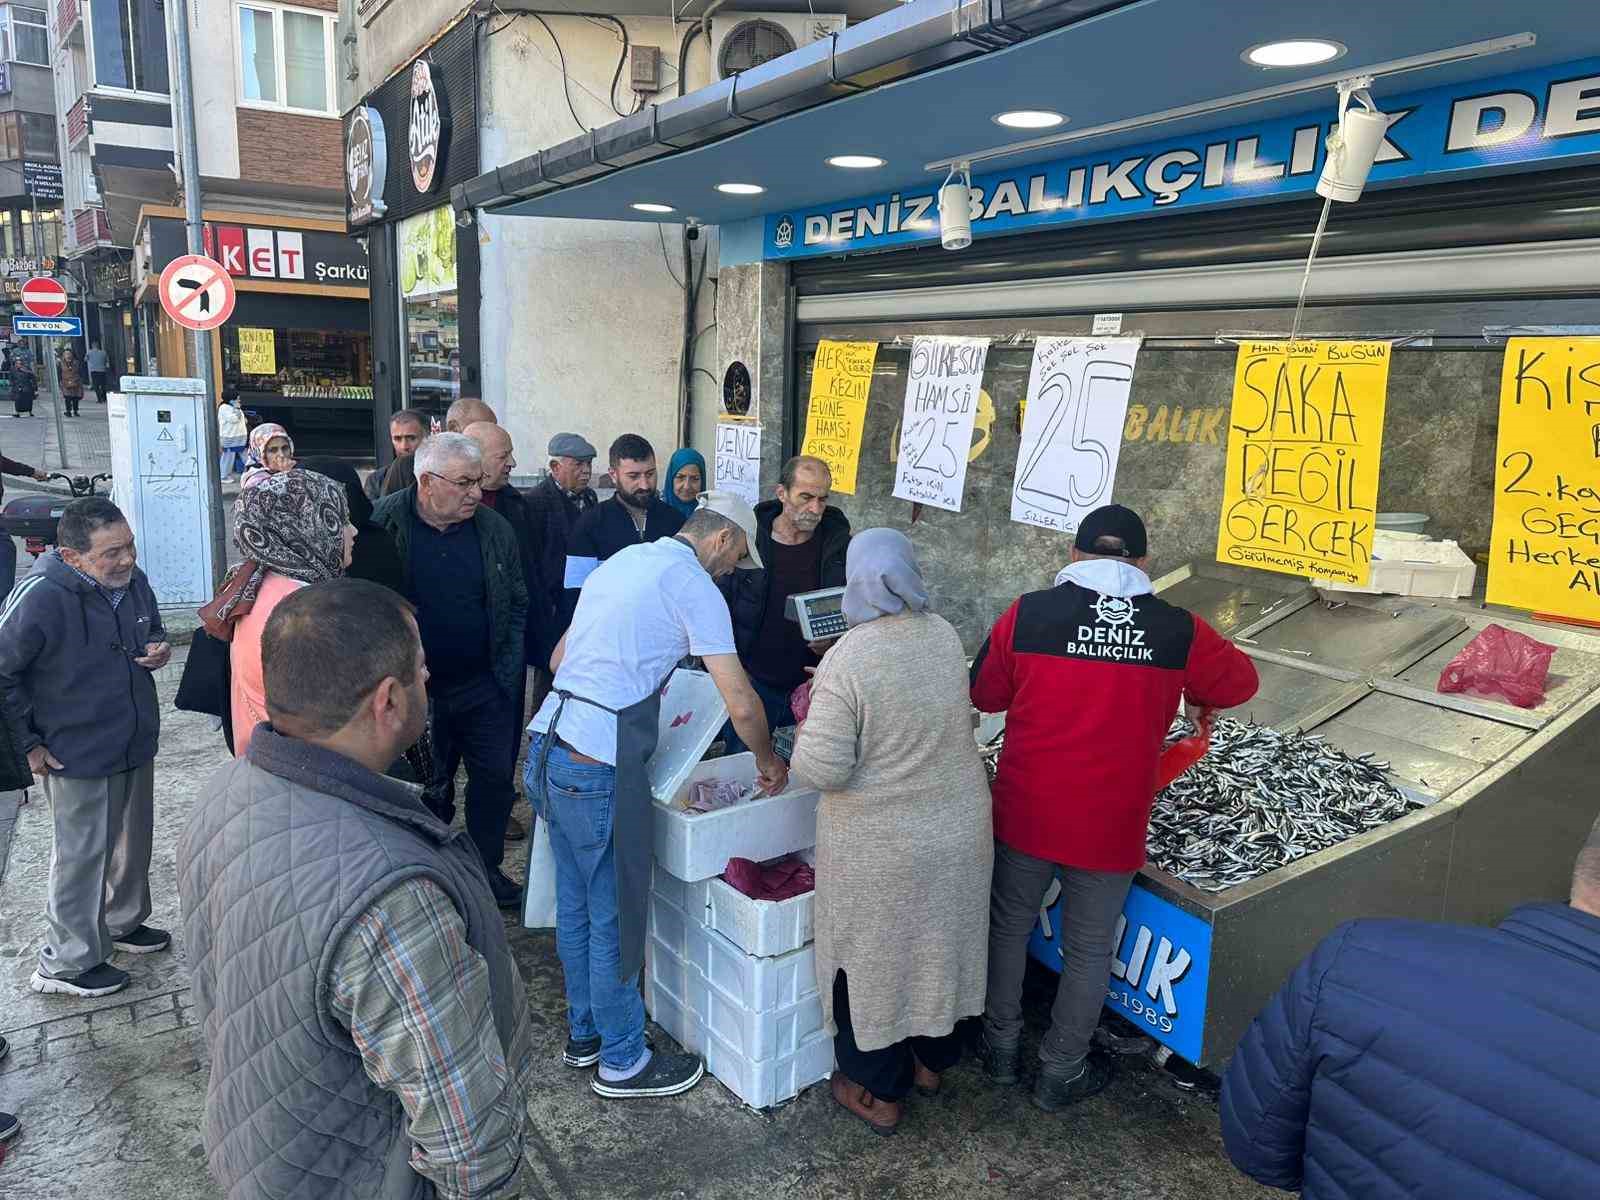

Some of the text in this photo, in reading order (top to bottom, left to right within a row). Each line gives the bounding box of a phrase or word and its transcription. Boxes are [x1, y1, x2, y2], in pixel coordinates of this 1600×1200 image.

[803, 193, 937, 246] DENİZ
[315, 262, 370, 281] Şarkü
[1232, 357, 1358, 443] ŞAKA
[912, 416, 959, 479] 25
[1015, 360, 1133, 517] 25
[1242, 444, 1373, 513] DEĞİL
[1226, 499, 1369, 563] GERÇEK
[1066, 642, 1153, 661] BALIKÇILIK
[1077, 625, 1145, 646] DENİZ
